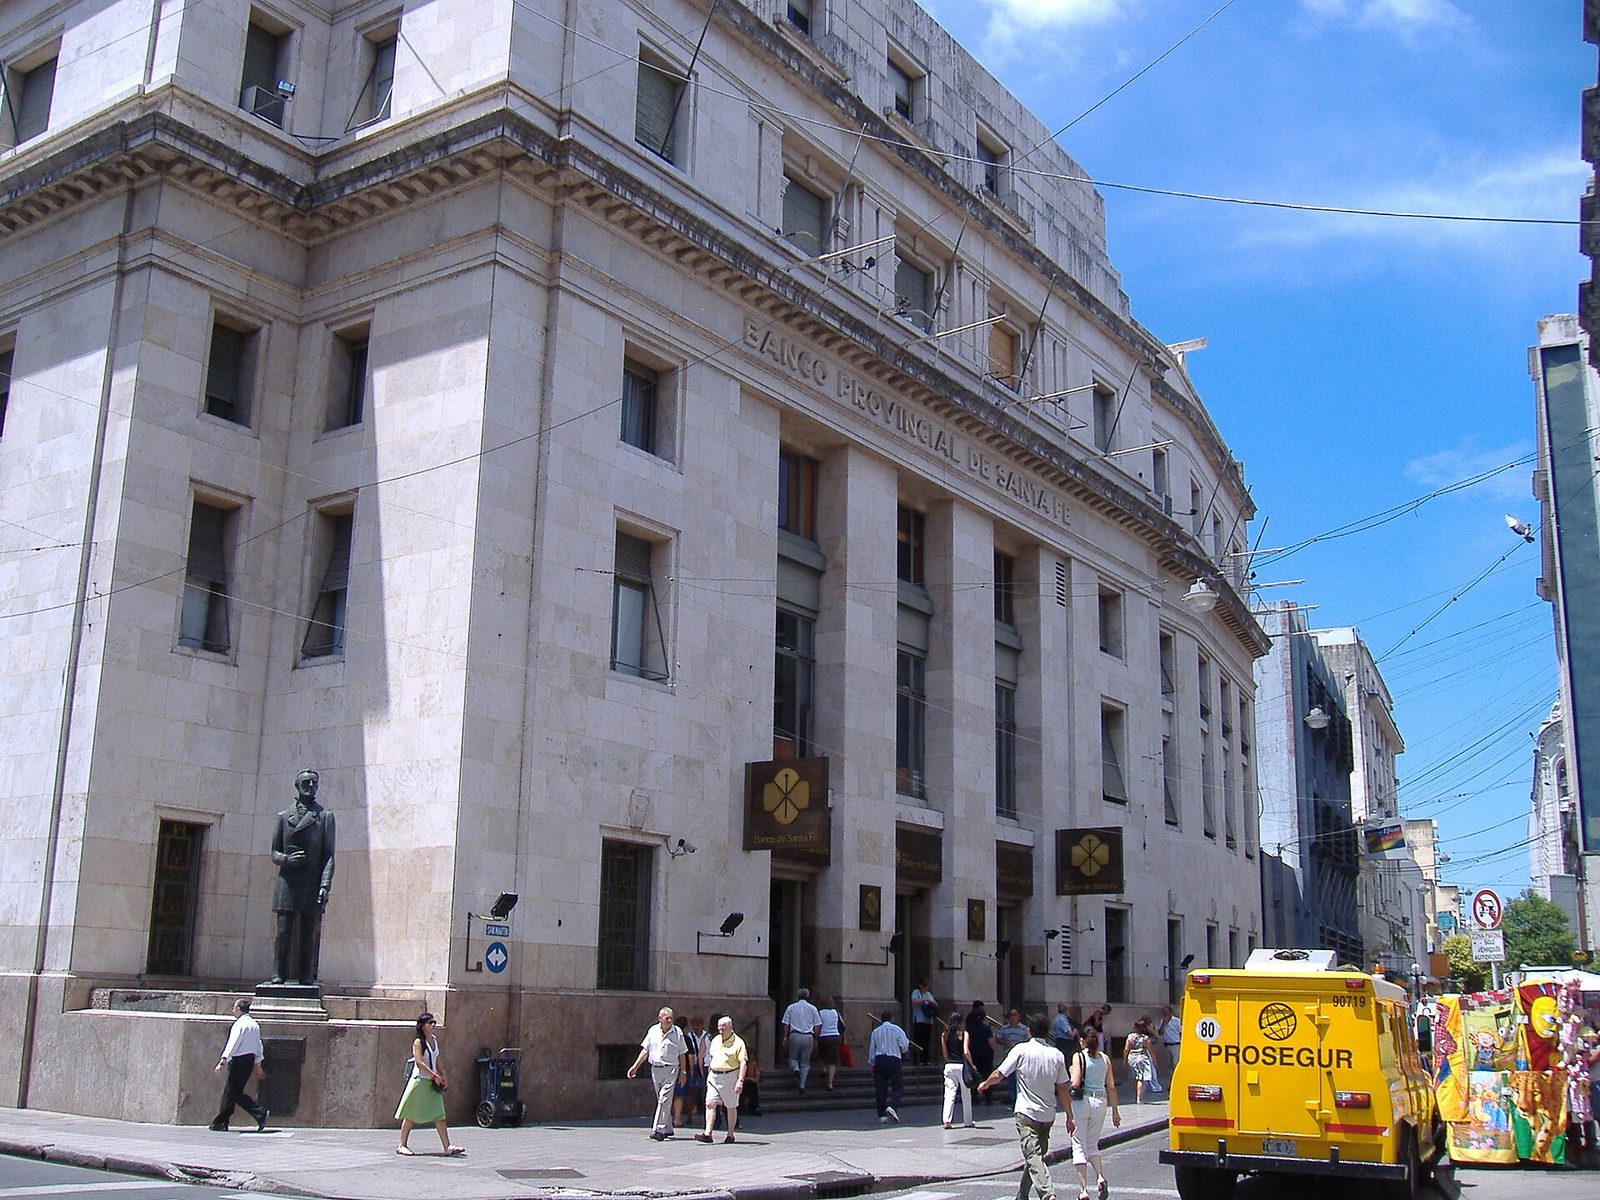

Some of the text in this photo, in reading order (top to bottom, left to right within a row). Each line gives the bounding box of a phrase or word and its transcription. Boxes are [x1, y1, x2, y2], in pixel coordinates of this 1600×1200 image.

[743, 318, 1072, 526] BANCO PROVINCIAL DE SANTA FE
[754, 834, 775, 845] Banco
[777, 834, 786, 844] de
[787, 833, 808, 843] Santa
[1332, 995, 1366, 1008] 90719
[1200, 1021, 1215, 1039] 80
[1207, 1044, 1353, 1069] PROSEGUR
